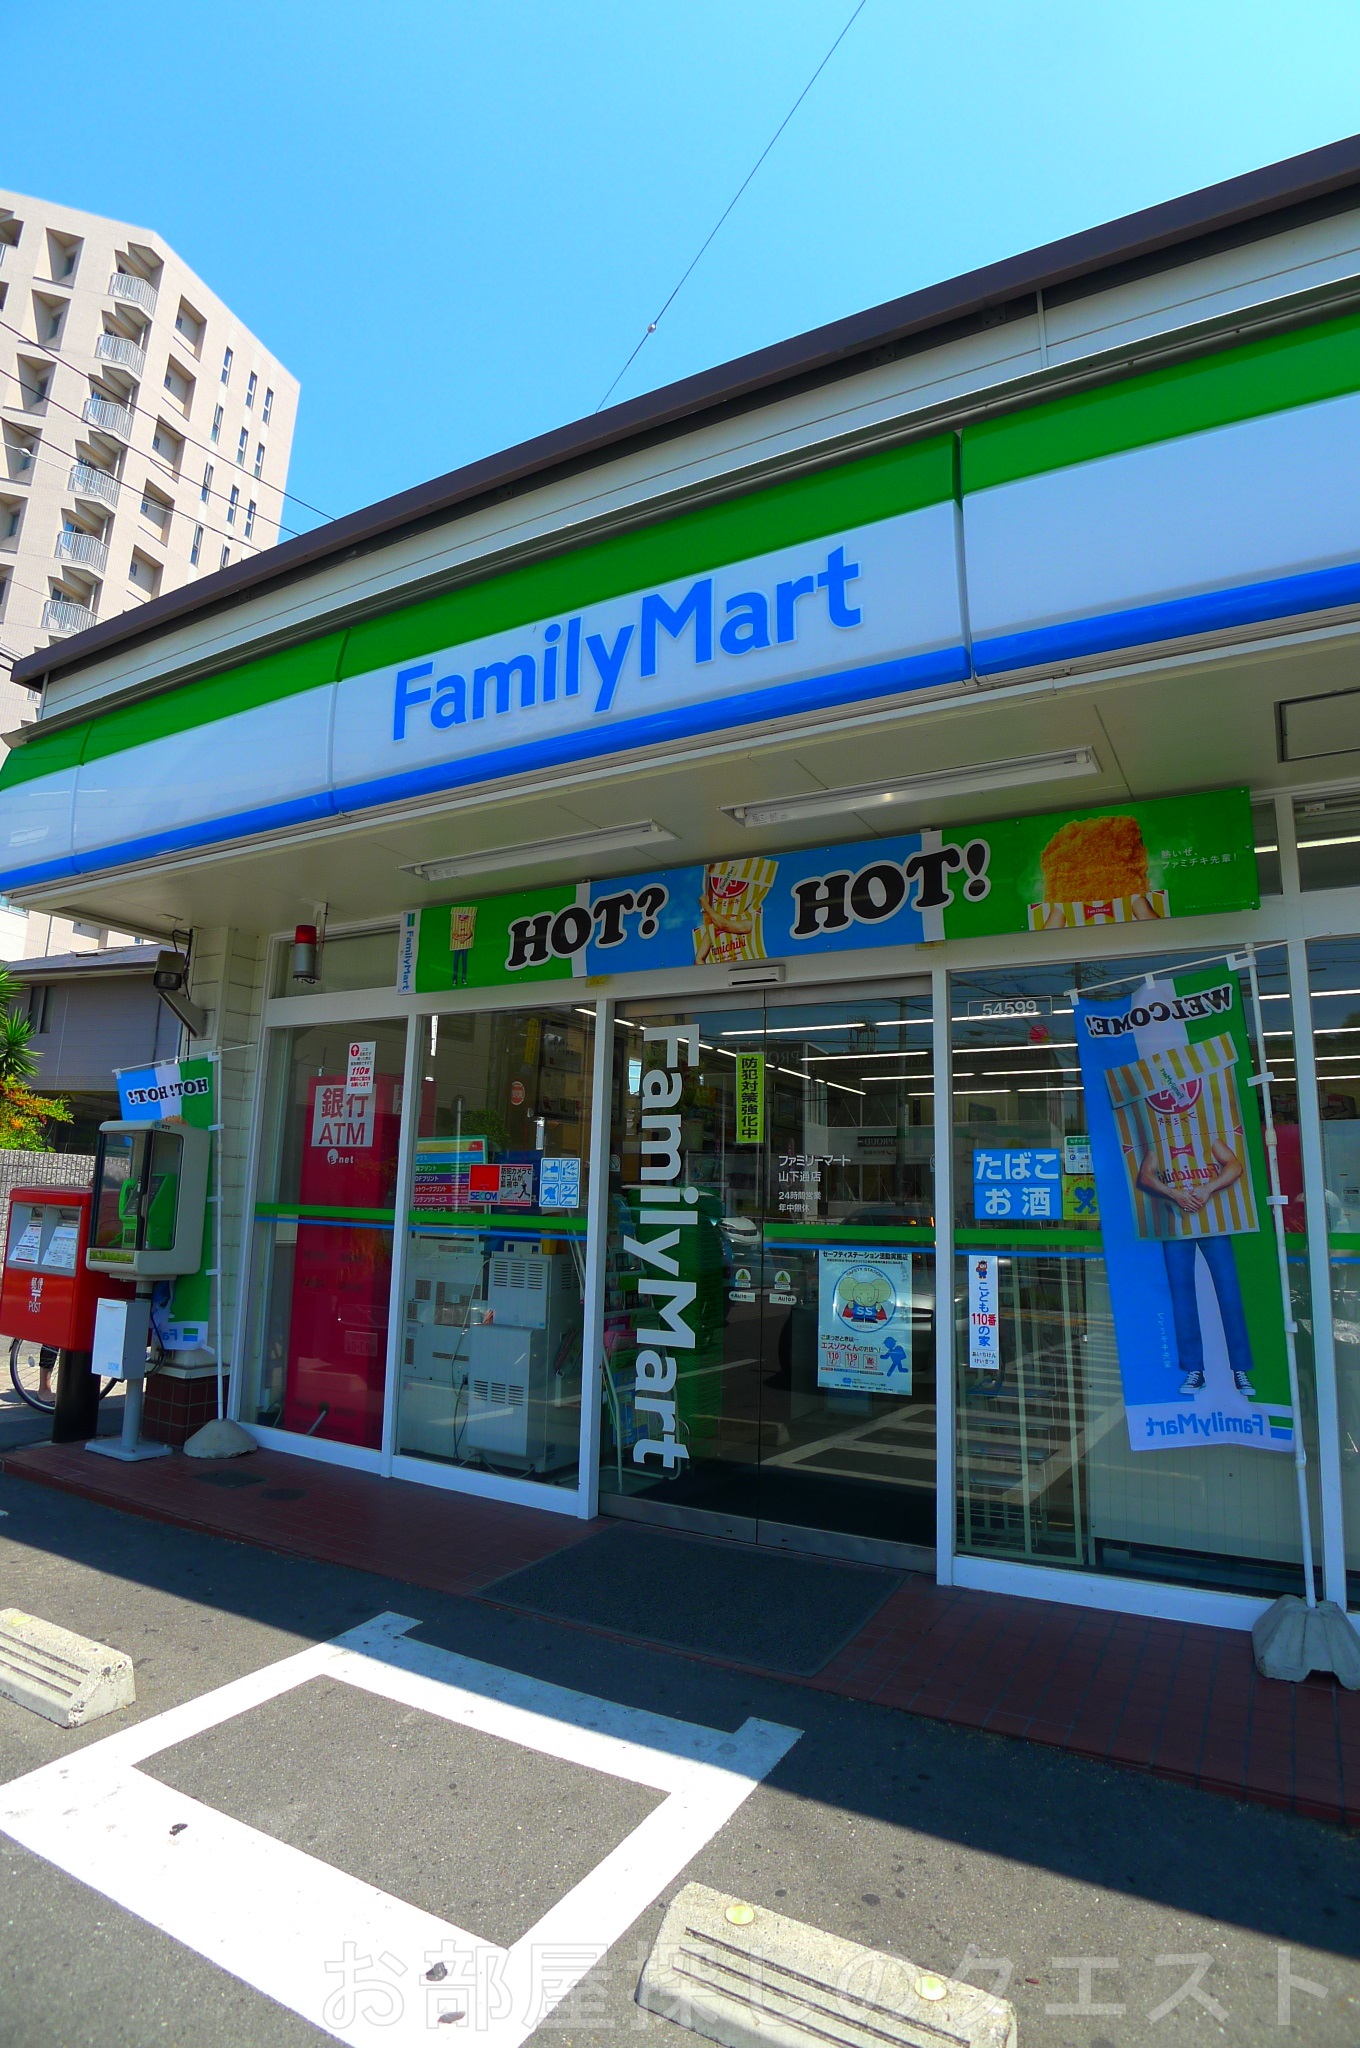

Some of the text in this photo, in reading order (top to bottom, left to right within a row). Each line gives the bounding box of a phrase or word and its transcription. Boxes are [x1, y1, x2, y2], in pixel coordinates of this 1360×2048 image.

[392, 544, 864, 743] FamilyMart
[506, 841, 988, 968] HOT? HOT!
[402, 930, 414, 990] FamilyMart
[982, 1000, 1037, 1016] 54599
[321, 1087, 369, 1119] 銀行
[741, 1057, 759, 1139] 防犯対策強化中
[318, 1122, 366, 1145] ATM
[778, 1155, 851, 1167] ファミリーマート
[976, 1152, 1059, 1180] たばこ
[778, 1170, 822, 1183] 山下通店
[470, 1191, 498, 1201] SECOM
[778, 1192, 822, 1201] 24時間営業
[985, 1187, 1051, 1216] お酒
[778, 1203, 810, 1213] 年中無休
[623, 1023, 700, 1469] FamilyMart
[28, 1300, 42, 1313] POST
[856, 1306, 873, 1316] SS
[828, 1351, 858, 1361] 110 119
